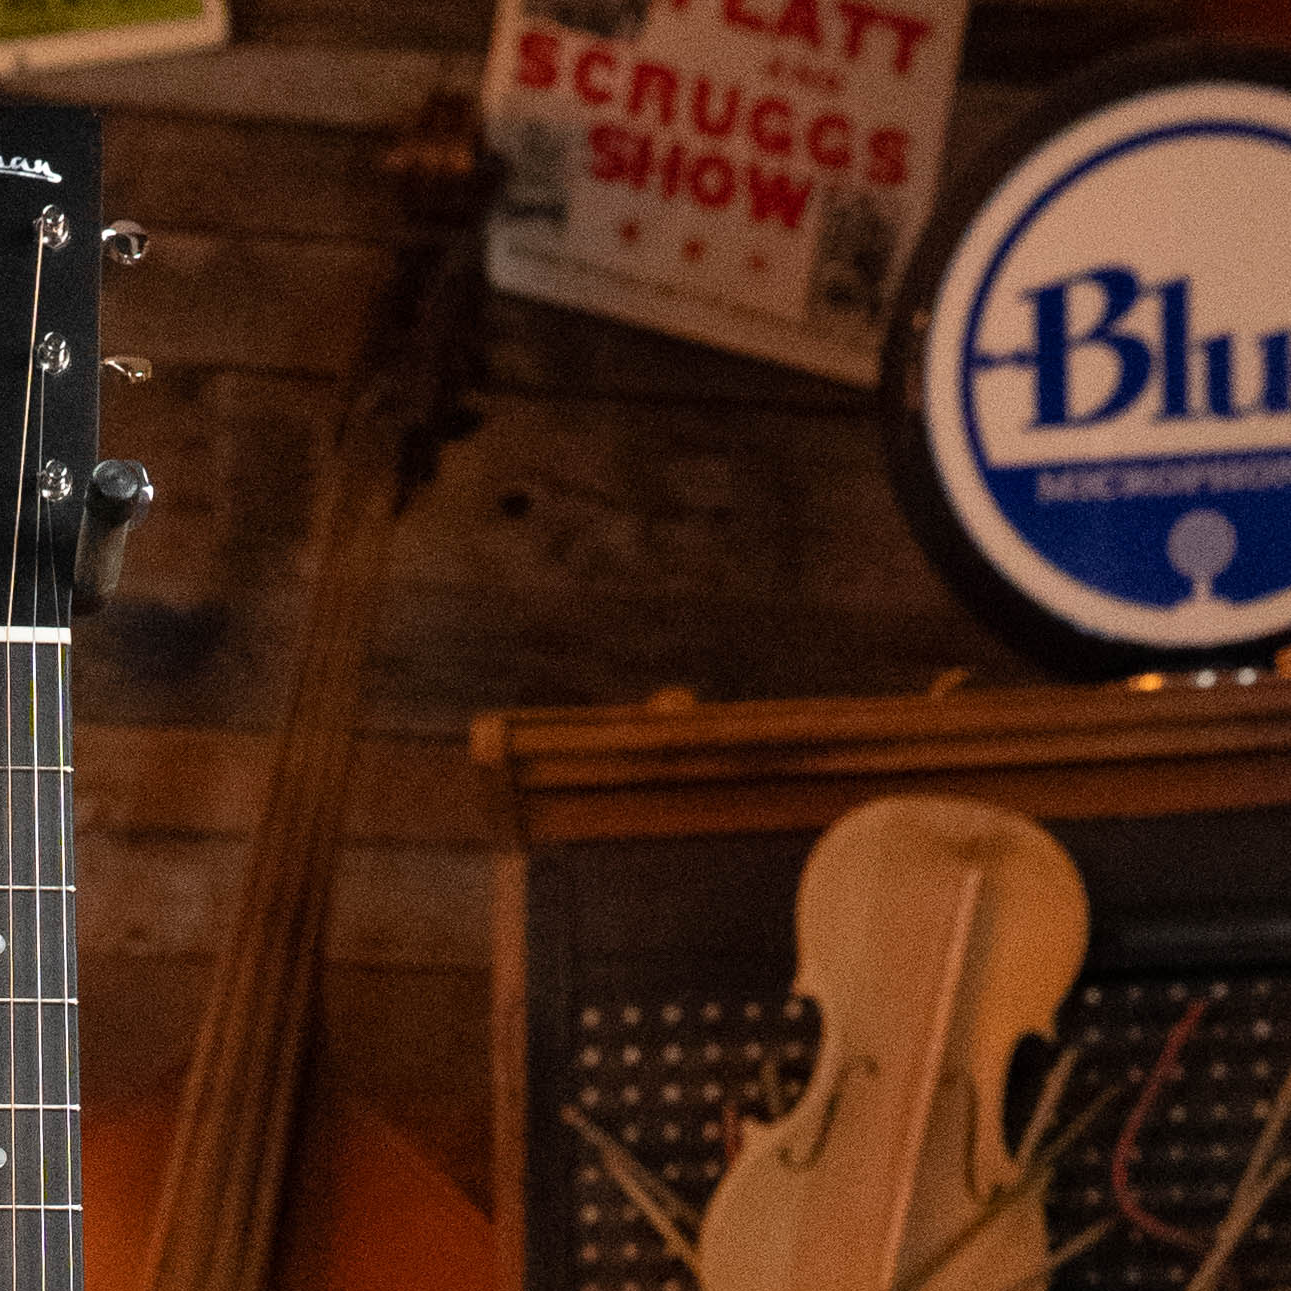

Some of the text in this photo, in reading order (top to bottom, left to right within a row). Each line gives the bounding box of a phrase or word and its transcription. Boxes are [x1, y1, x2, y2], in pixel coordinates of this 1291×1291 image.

[666, 0, 934, 76] LATT
[516, 30, 912, 188] SCRUGGS
[589, 122, 814, 230] SHOW
